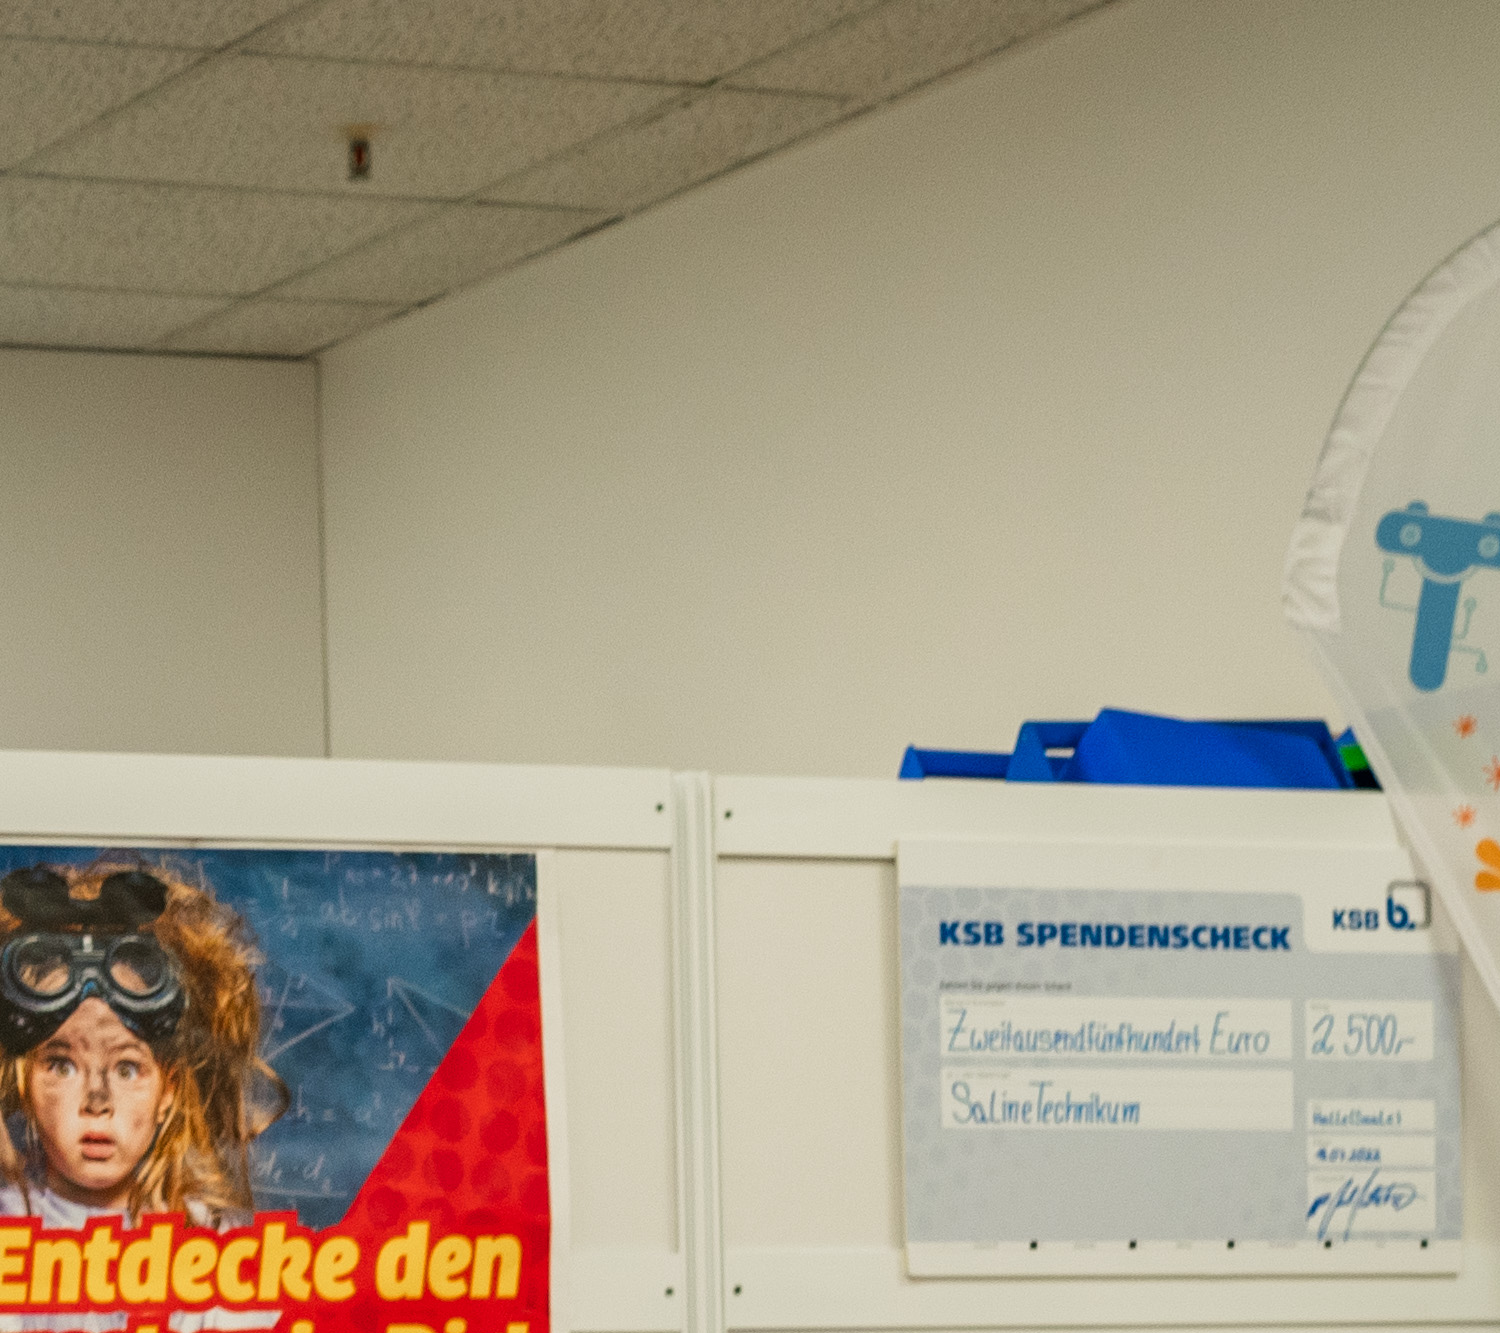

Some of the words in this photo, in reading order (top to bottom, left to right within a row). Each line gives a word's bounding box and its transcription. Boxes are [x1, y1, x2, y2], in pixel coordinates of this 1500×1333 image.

[939, 922, 1004, 946] KSB
[1016, 922, 1291, 950] SPENDENSCHECK
[1333, 908, 1379, 931] KSB
[1208, 1010, 1270, 1056] Euro
[376, 1222, 523, 1300] den
